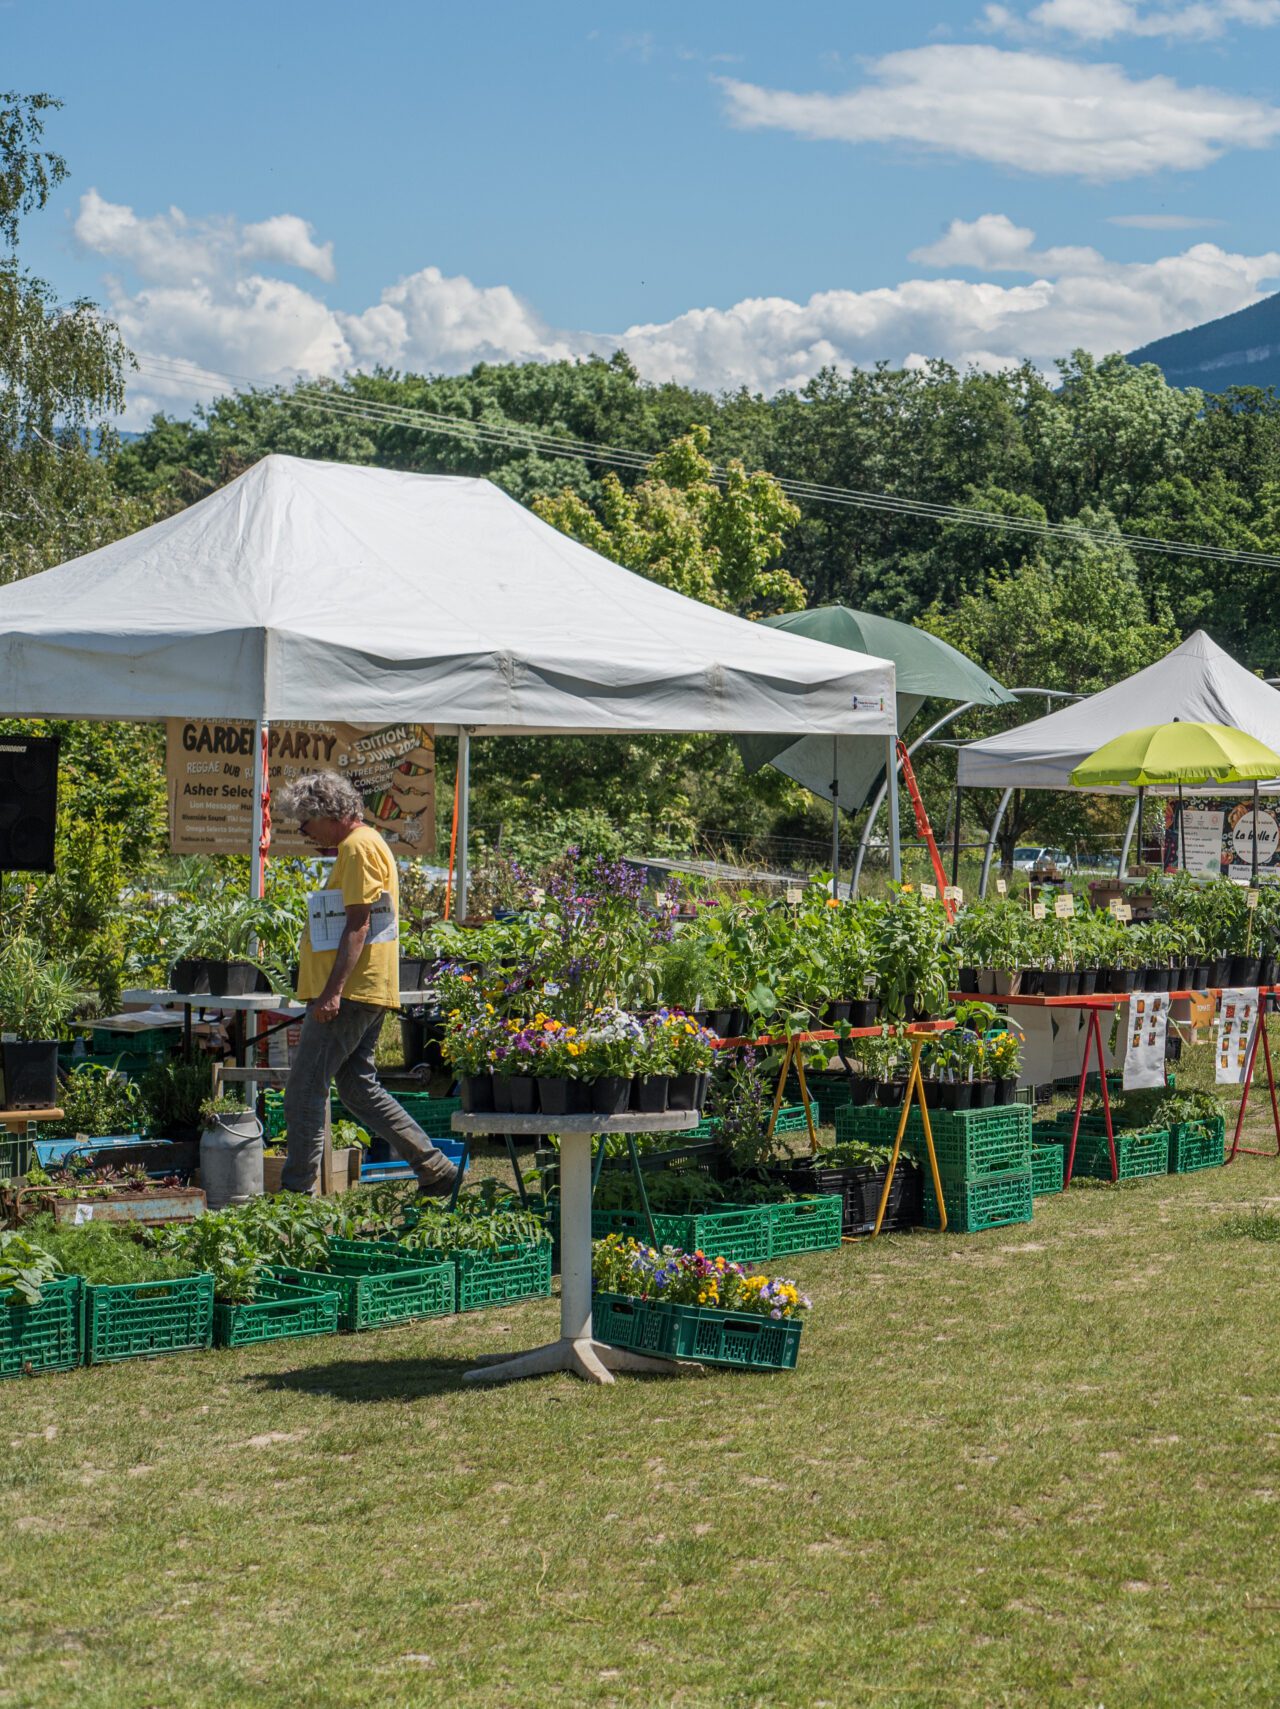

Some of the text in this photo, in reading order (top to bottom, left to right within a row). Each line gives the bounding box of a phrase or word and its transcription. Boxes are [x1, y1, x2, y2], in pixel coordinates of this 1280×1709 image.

[269, 728, 337, 761] PARTY
[367, 747, 396, 764] JUIN
[187, 761, 220, 774] REGGAE
[223, 763, 240, 777] DUB
[354, 771, 394, 787] CONSCIENT
[183, 782, 256, 798] Asher Selec
[190, 801, 204, 809] Lion
[1235, 830, 1245, 840] La
